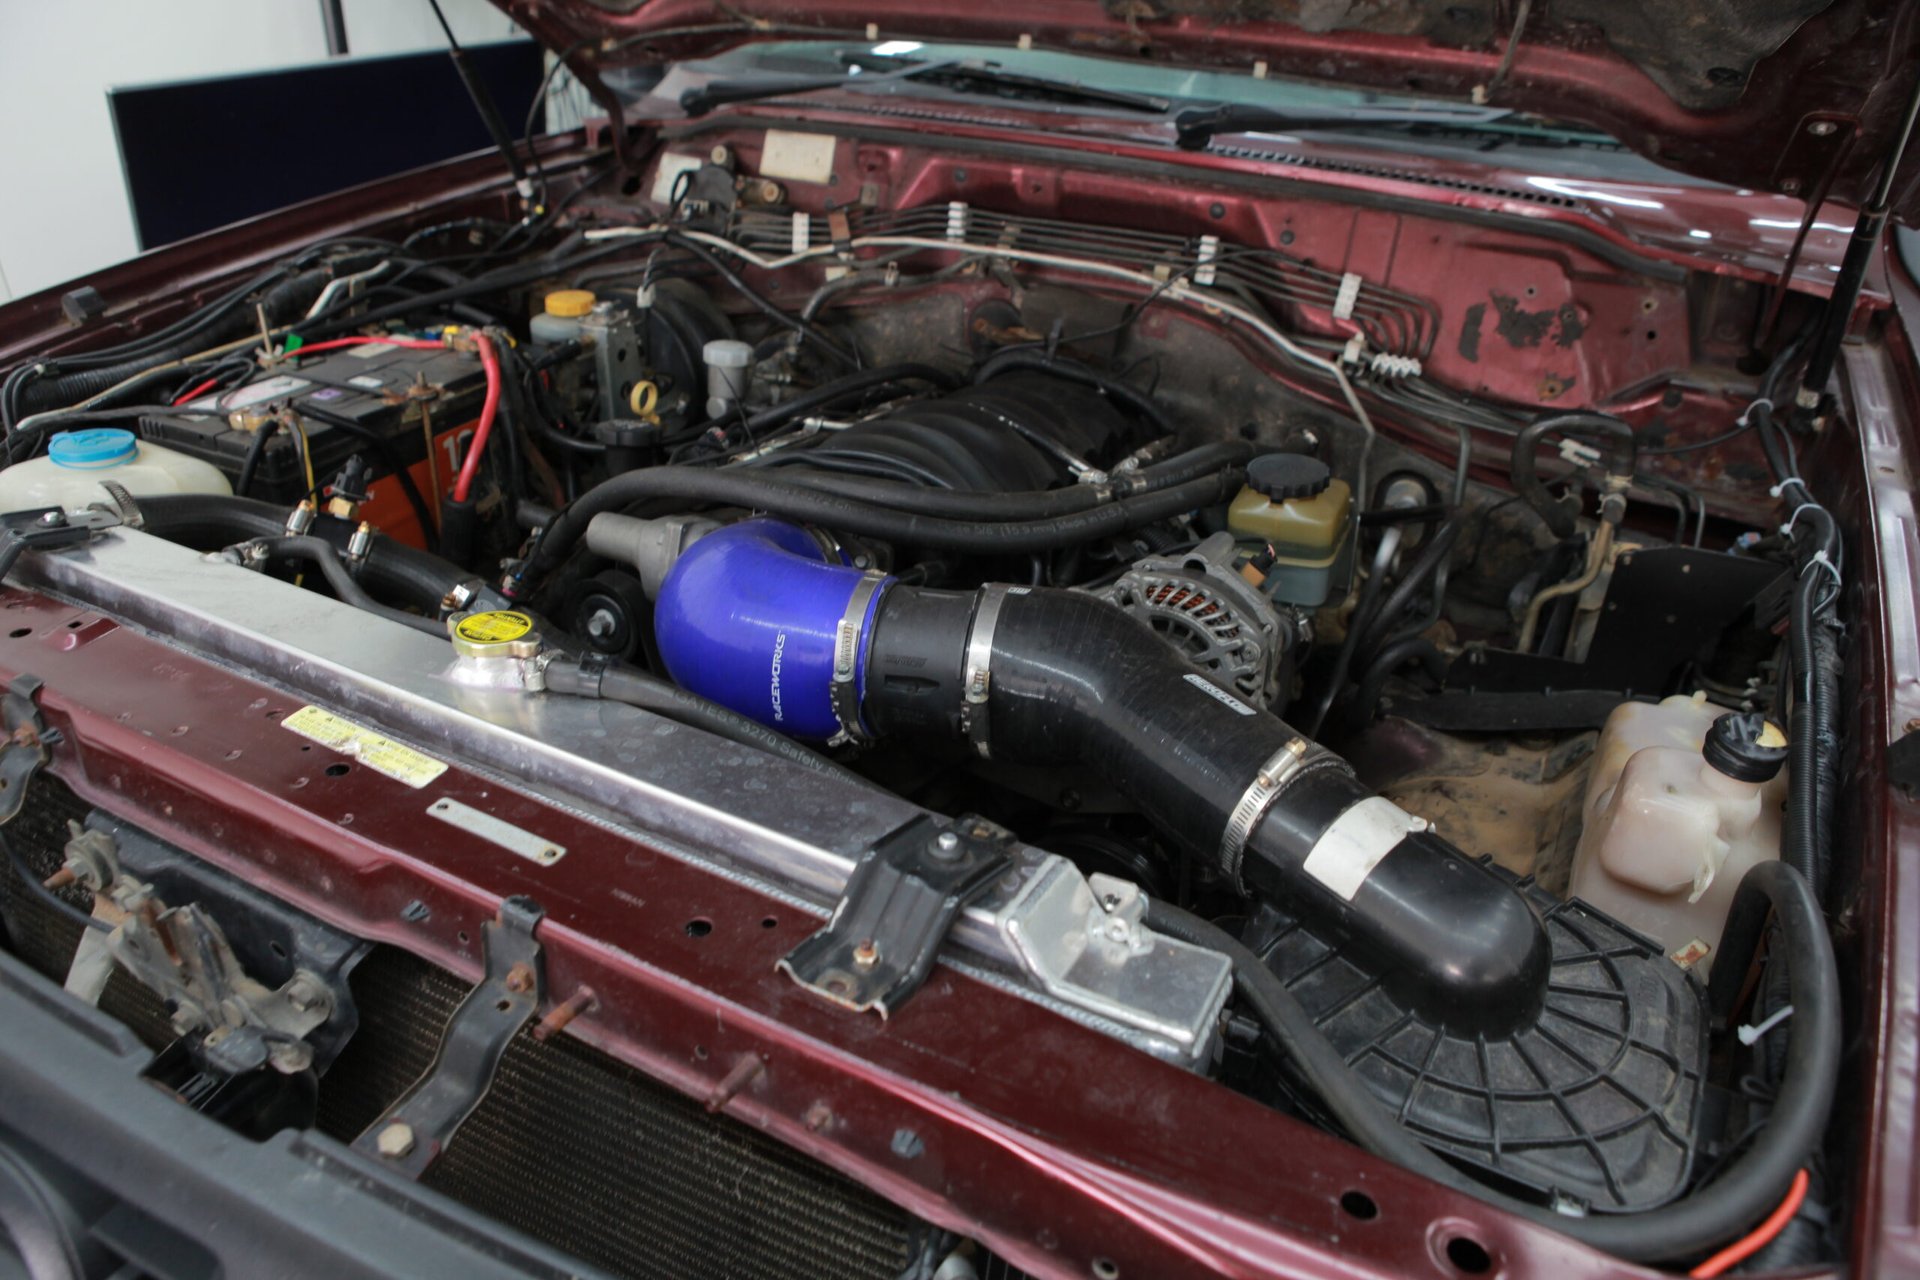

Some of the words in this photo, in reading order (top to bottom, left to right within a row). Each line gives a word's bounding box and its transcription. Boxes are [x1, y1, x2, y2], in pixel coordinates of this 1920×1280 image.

[770, 632, 786, 721] RACEWORKS
[740, 720, 777, 747] 3270
[779, 737, 824, 771] Safety
